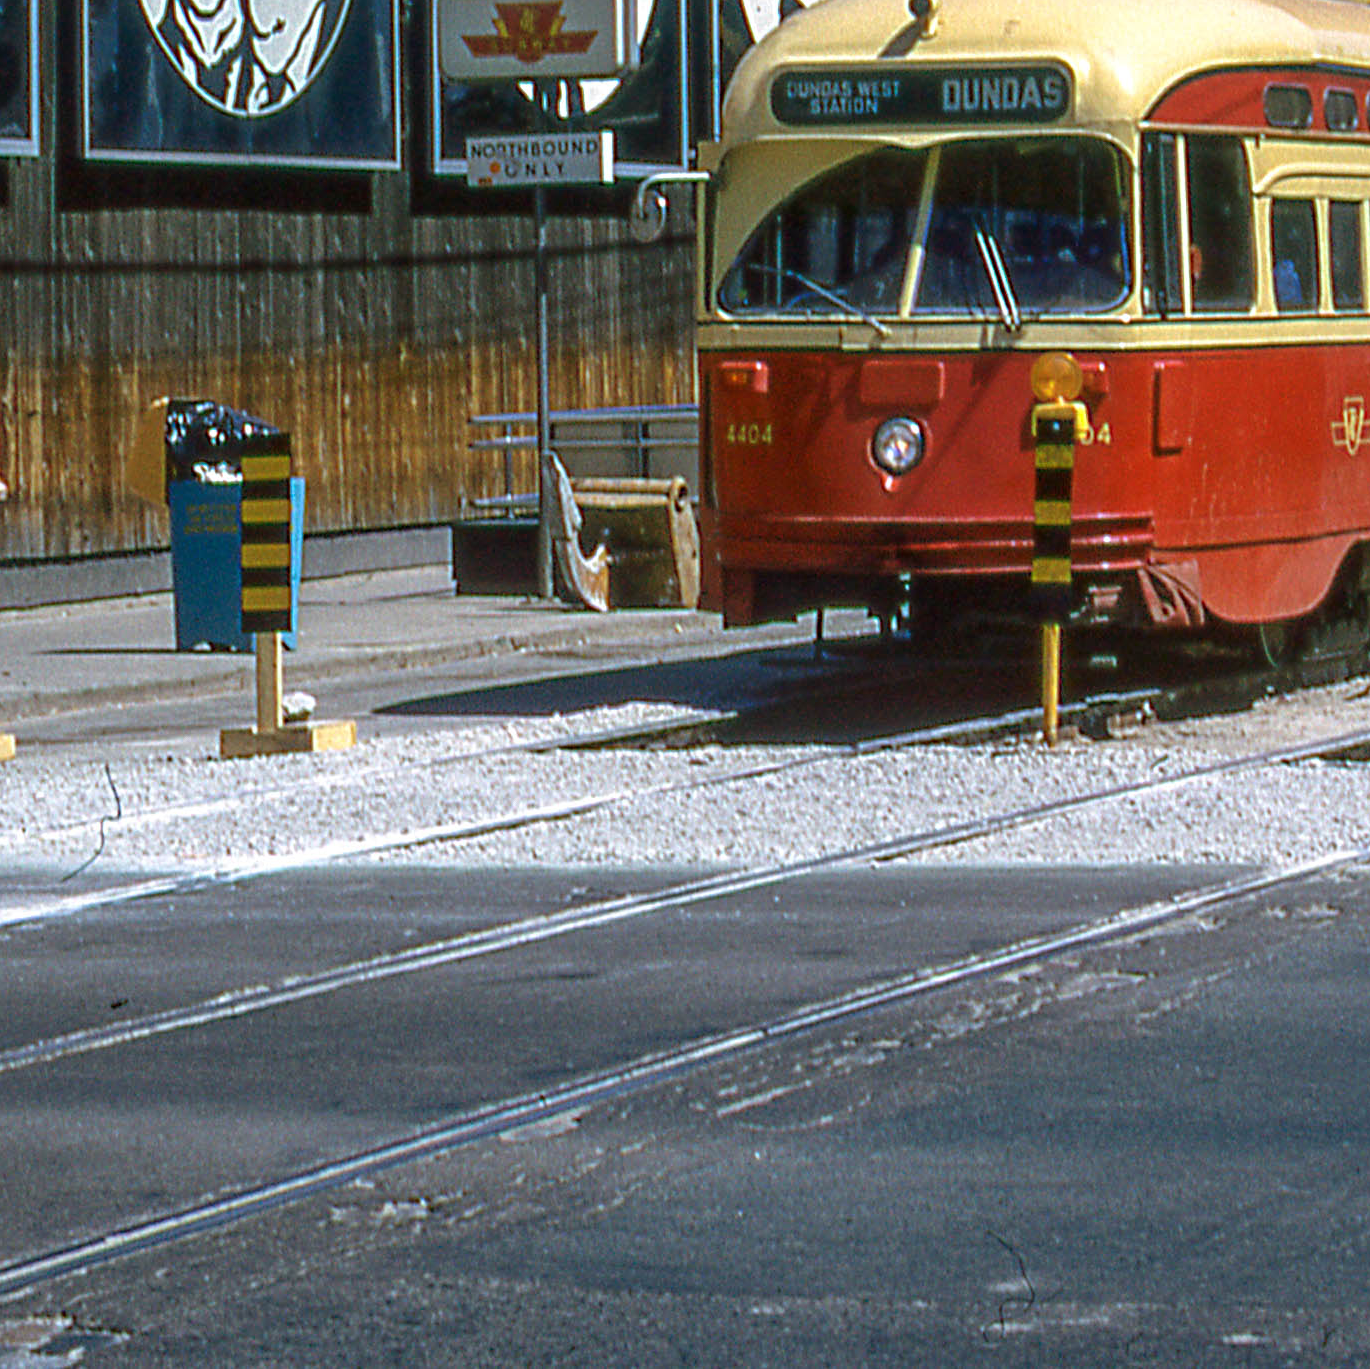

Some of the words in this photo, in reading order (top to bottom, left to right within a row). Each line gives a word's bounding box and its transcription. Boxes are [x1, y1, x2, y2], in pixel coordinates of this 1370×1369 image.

[787, 80, 852, 98] DUNDAS
[857, 79, 900, 97] WEST
[942, 77, 1063, 112] DUNDAS
[809, 96, 879, 115] STATION
[470, 140, 599, 159] NORTHBOUND
[504, 162, 565, 178] ONLY
[727, 423, 772, 445] 4404
